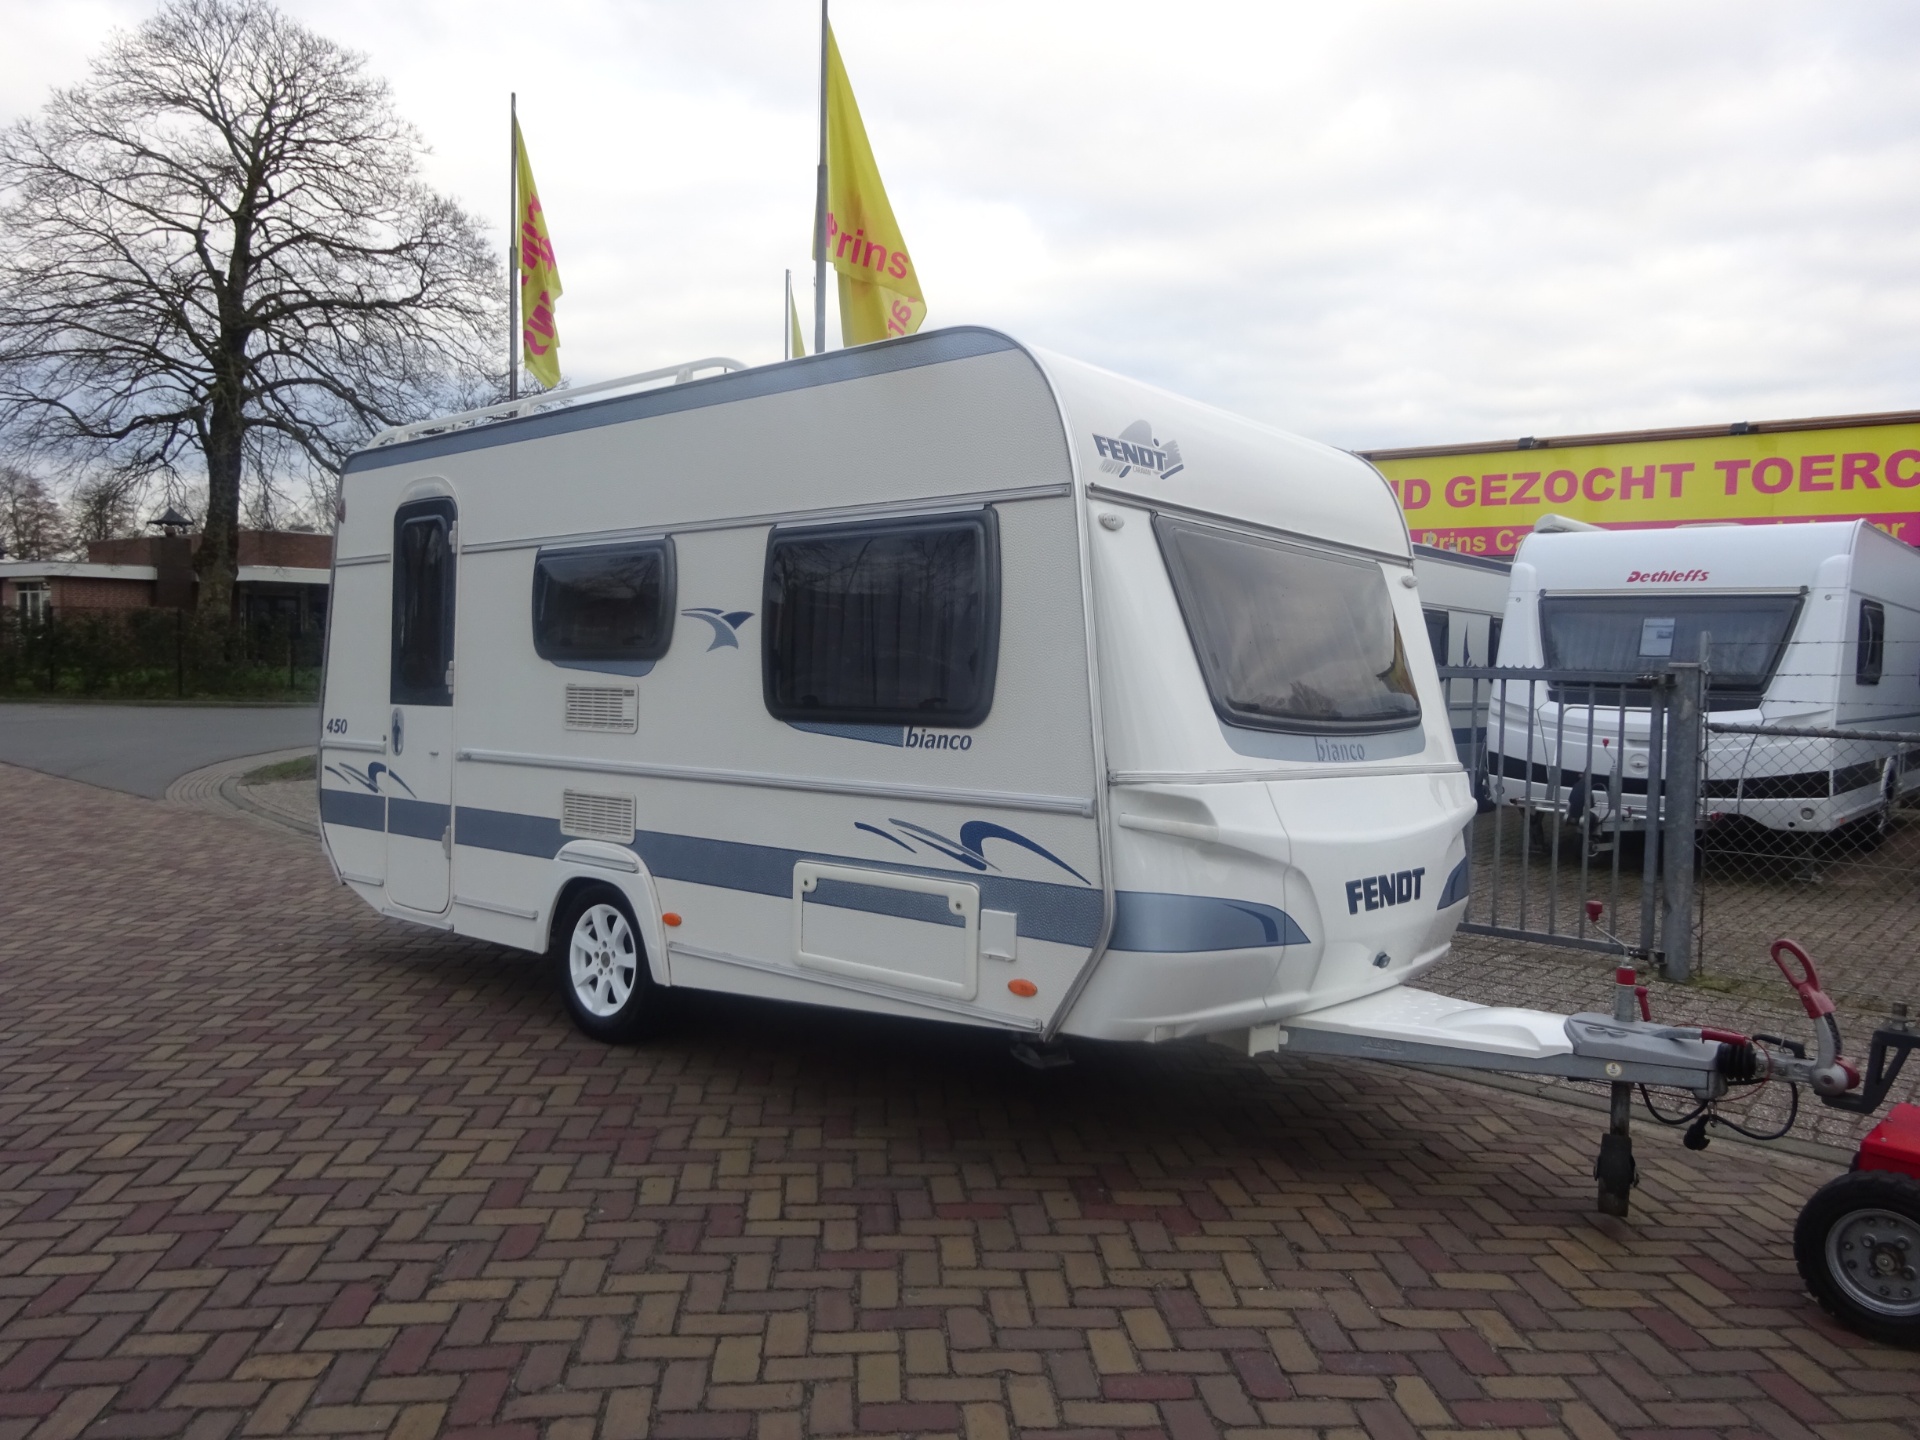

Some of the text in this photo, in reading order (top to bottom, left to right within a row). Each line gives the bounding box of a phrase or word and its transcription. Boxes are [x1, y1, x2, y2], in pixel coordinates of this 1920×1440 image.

[826, 212, 909, 279] Prins
[1092, 433, 1166, 472] FENDT
[1445, 462, 1695, 508] GEZOCHT
[1714, 449, 1920, 496] TOERC
[1422, 531, 1487, 552] Prins
[1627, 569, 1710, 583] Dethleffs
[326, 718, 348, 734] 450
[905, 726, 973, 750] bianco
[1313, 736, 1365, 761] bianco
[1345, 867, 1425, 915] FENDT
